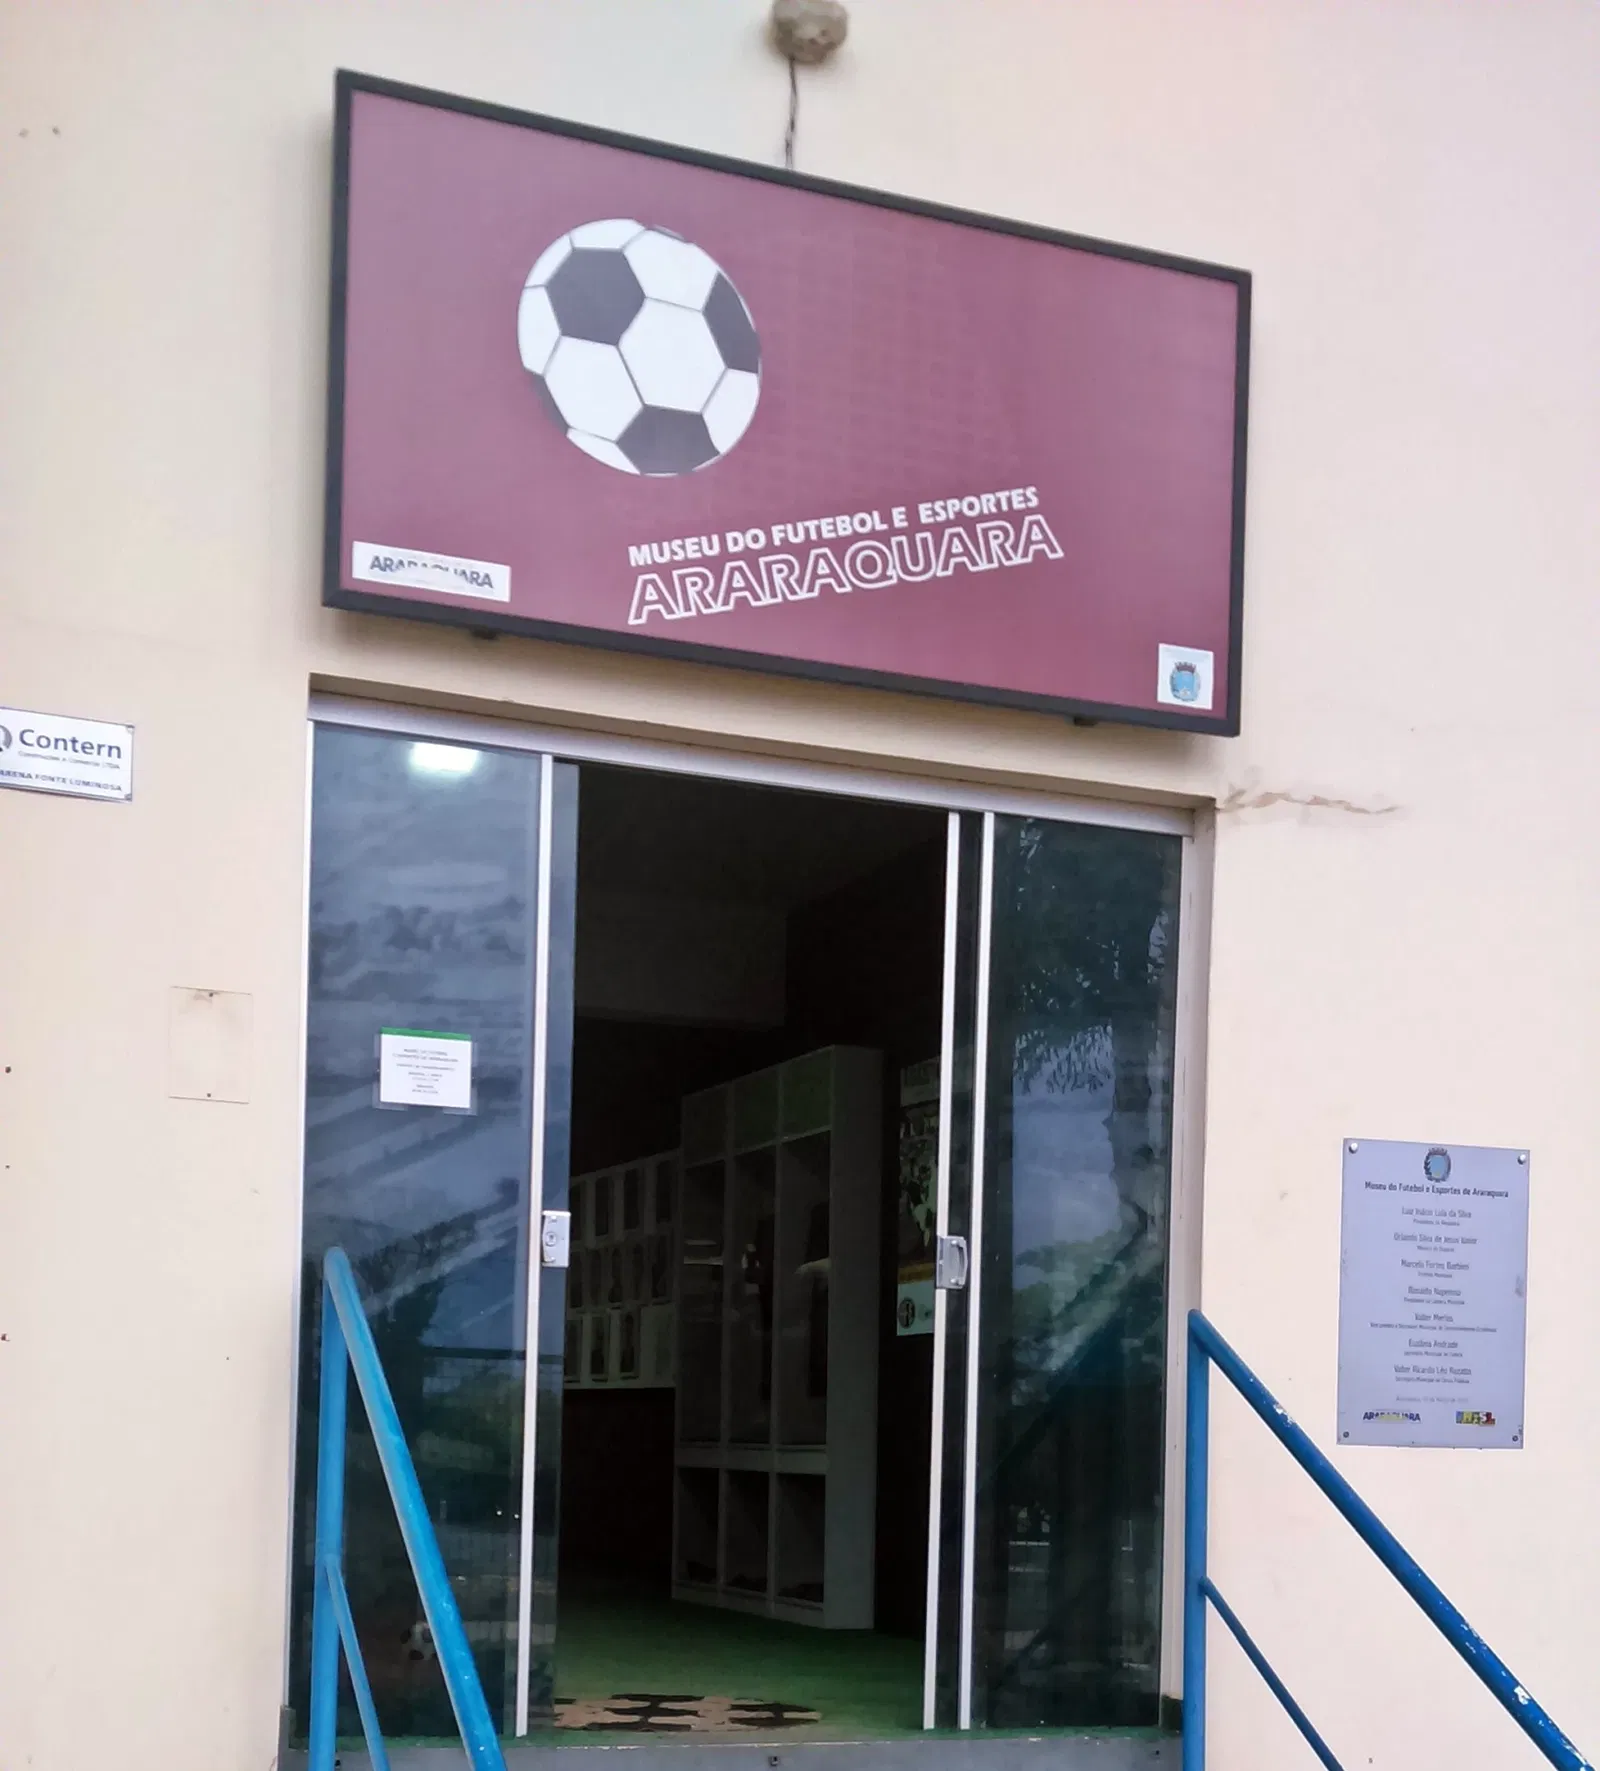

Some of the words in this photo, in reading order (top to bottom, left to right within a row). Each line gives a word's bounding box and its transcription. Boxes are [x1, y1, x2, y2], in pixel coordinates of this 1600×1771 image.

[627, 534, 721, 567] MUSEU
[725, 528, 766, 554] DO
[770, 510, 888, 547] FUTEBOL
[891, 506, 908, 528] E
[918, 486, 1040, 524] ESPORTES
[627, 514, 1065, 625] ARARAQUARA
[19, 729, 122, 759] Contern
[35, 773, 67, 784] FONTE
[69, 778, 122, 791] LUMINOSA
[1365, 1181, 1387, 1190] Museu
[1388, 1183, 1397, 1191] do
[1399, 1183, 1424, 1193] Futebol
[1432, 1185, 1461, 1196] Esportes
[1462, 1187, 1471, 1196] de
[1472, 1188, 1509, 1198] Araraquara
[1434, 1208, 1447, 1217] Lula
[1448, 1209, 1457, 1217] da
[1457, 1209, 1472, 1218] Silva
[1418, 1233, 1433, 1242] Silva
[1434, 1234, 1443, 1243] de
[1401, 1258, 1425, 1268] Marcelo
[1433, 1339, 1459, 1348] Andrade
[1412, 1365, 1435, 1374] Ricardo
